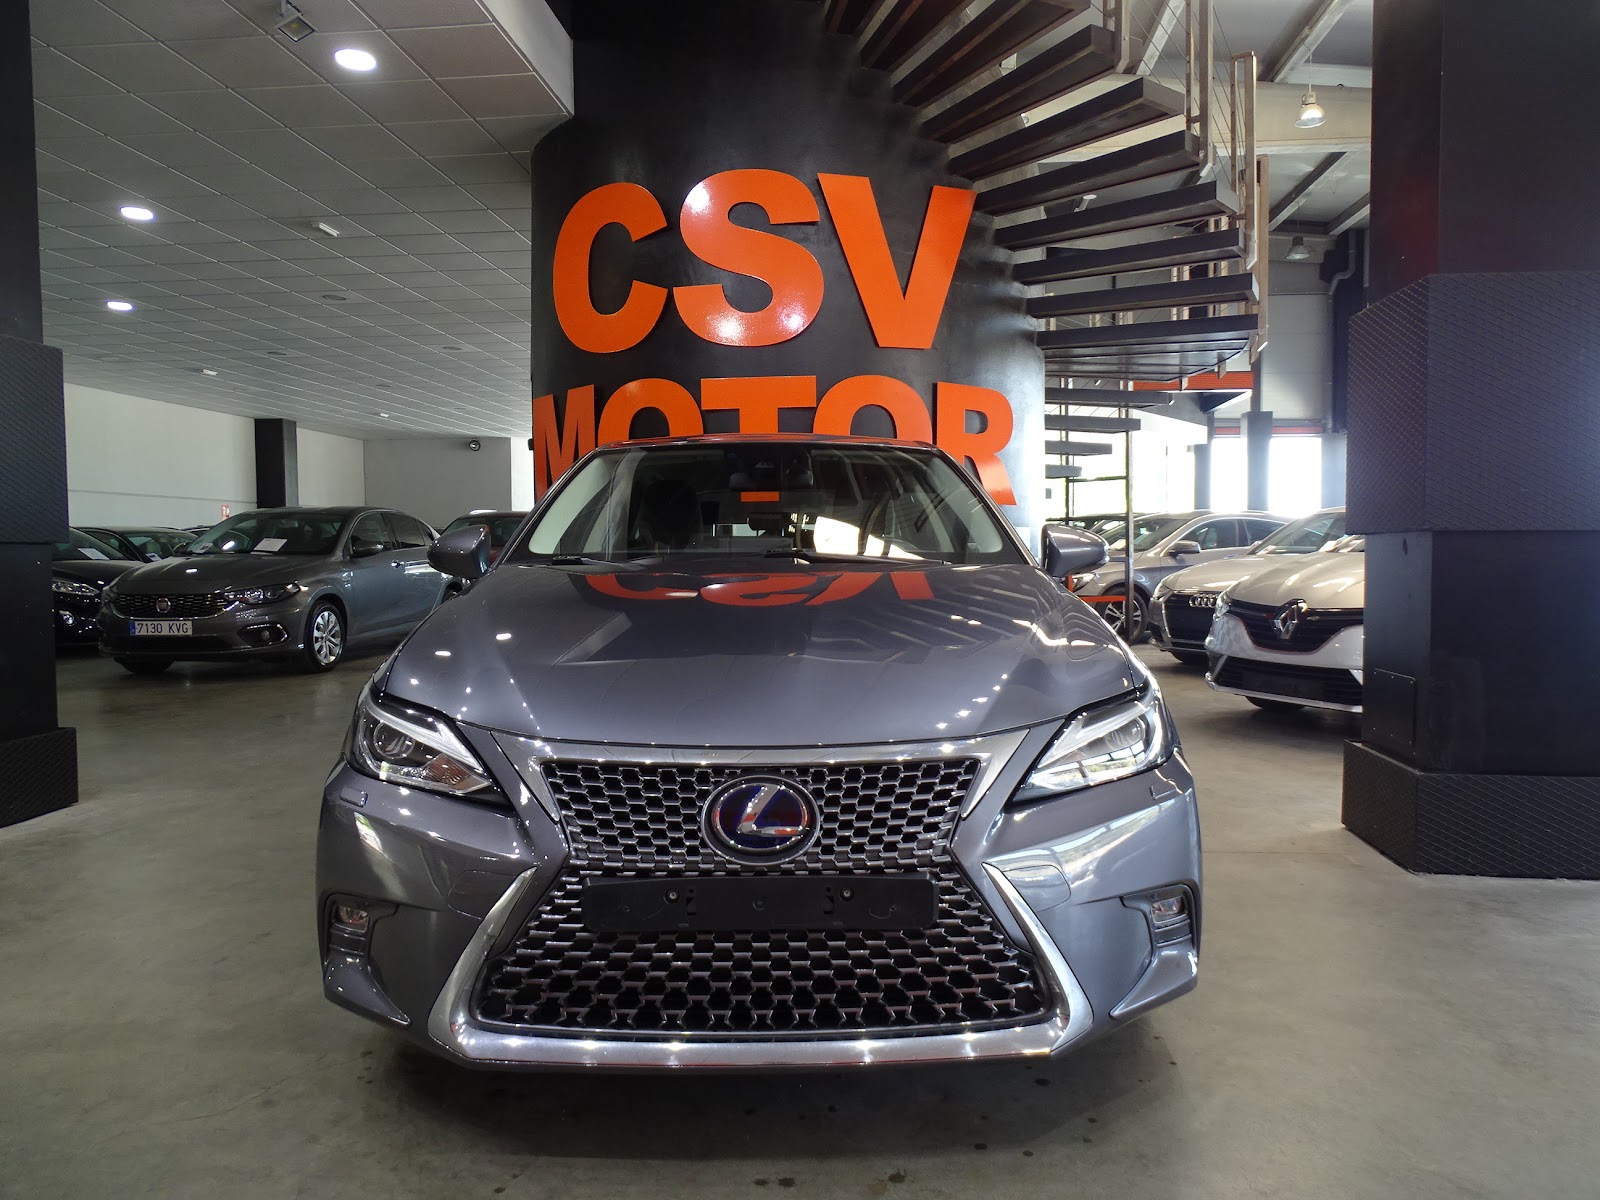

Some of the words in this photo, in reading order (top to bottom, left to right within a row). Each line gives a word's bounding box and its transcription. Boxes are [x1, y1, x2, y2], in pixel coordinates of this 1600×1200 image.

[553, 168, 977, 353] CSV
[137, 622, 163, 634] 7130
[168, 622, 189, 634] KVG
